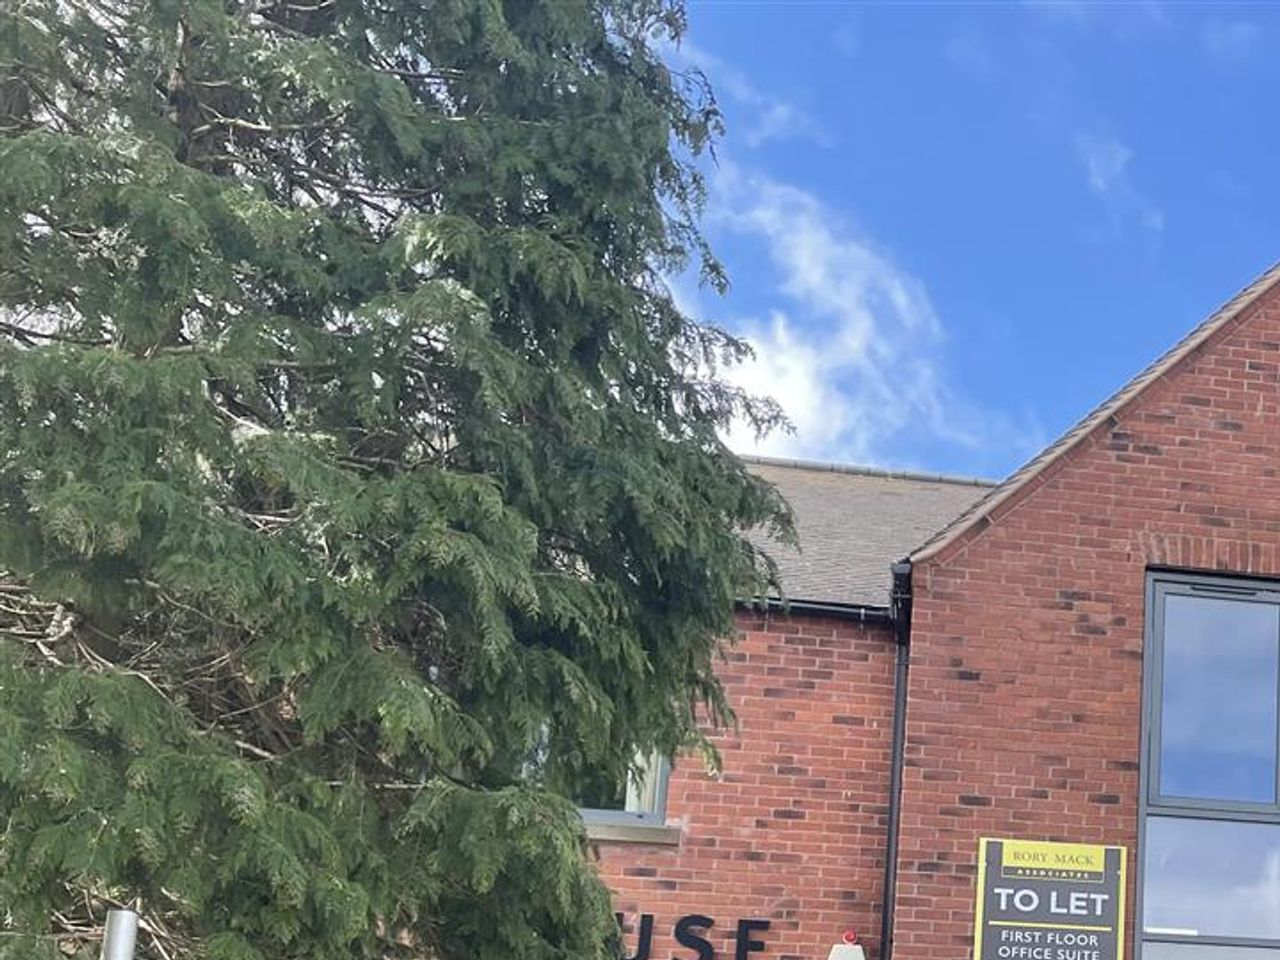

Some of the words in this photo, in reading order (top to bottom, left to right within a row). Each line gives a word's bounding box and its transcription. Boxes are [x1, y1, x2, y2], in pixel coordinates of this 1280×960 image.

[1013, 851, 1047, 862] RORY
[1054, 854, 1094, 866] MACK
[994, 888, 1039, 911] TO
[1050, 891, 1109, 915] LET
[1001, 930, 1041, 943] FIRST
[1047, 933, 1098, 946] FLOOR
[998, 946, 1052, 960] OFFICE
